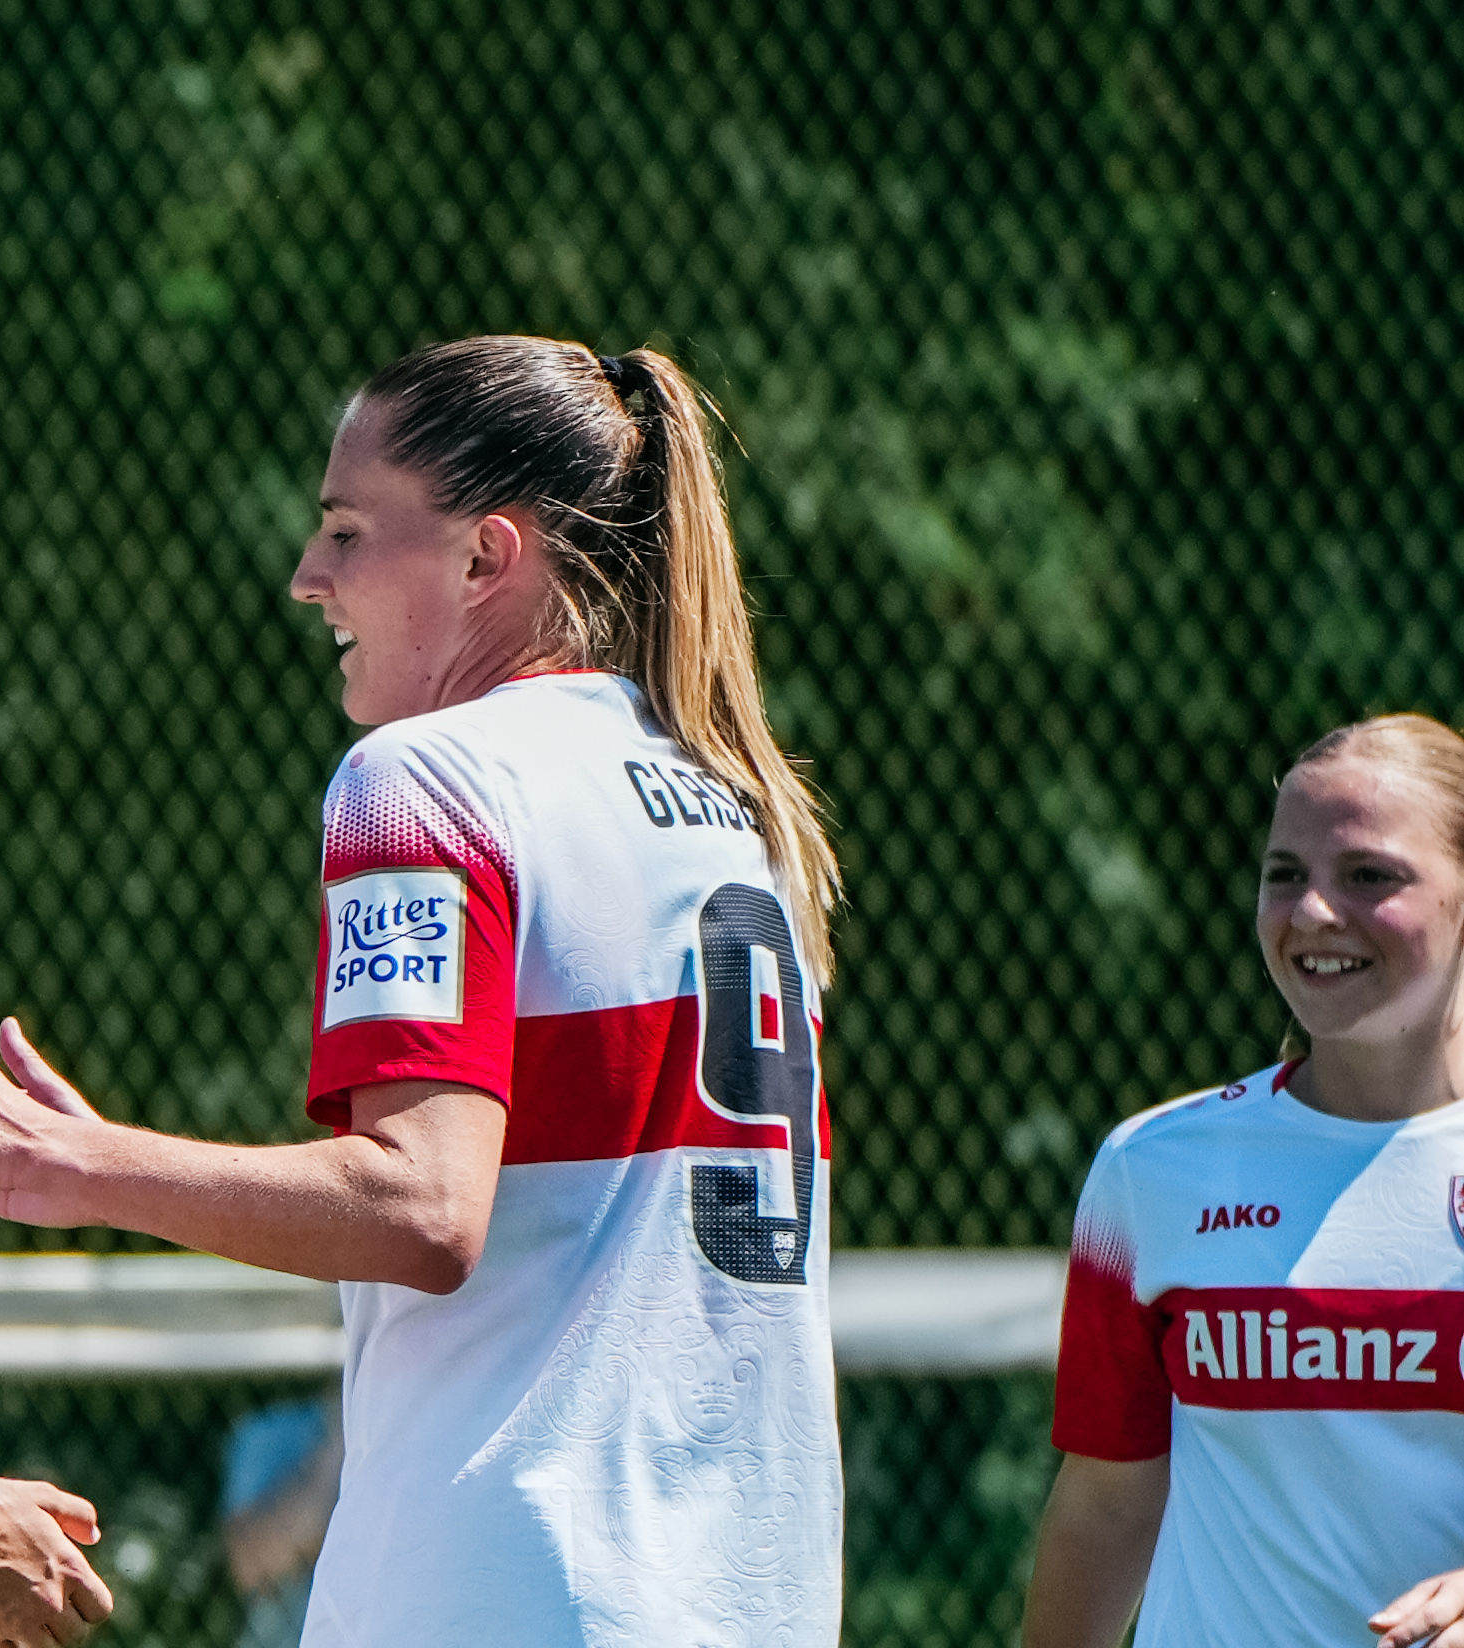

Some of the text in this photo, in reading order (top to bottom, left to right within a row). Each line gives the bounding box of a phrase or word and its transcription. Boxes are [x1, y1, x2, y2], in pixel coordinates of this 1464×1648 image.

[337, 896, 447, 958] Ritter
[333, 953, 447, 992] SPORT
[690, 882, 814, 1286] 9
[1195, 1204, 1281, 1235] JAKO
[1184, 1308, 1438, 1383] Allianz
